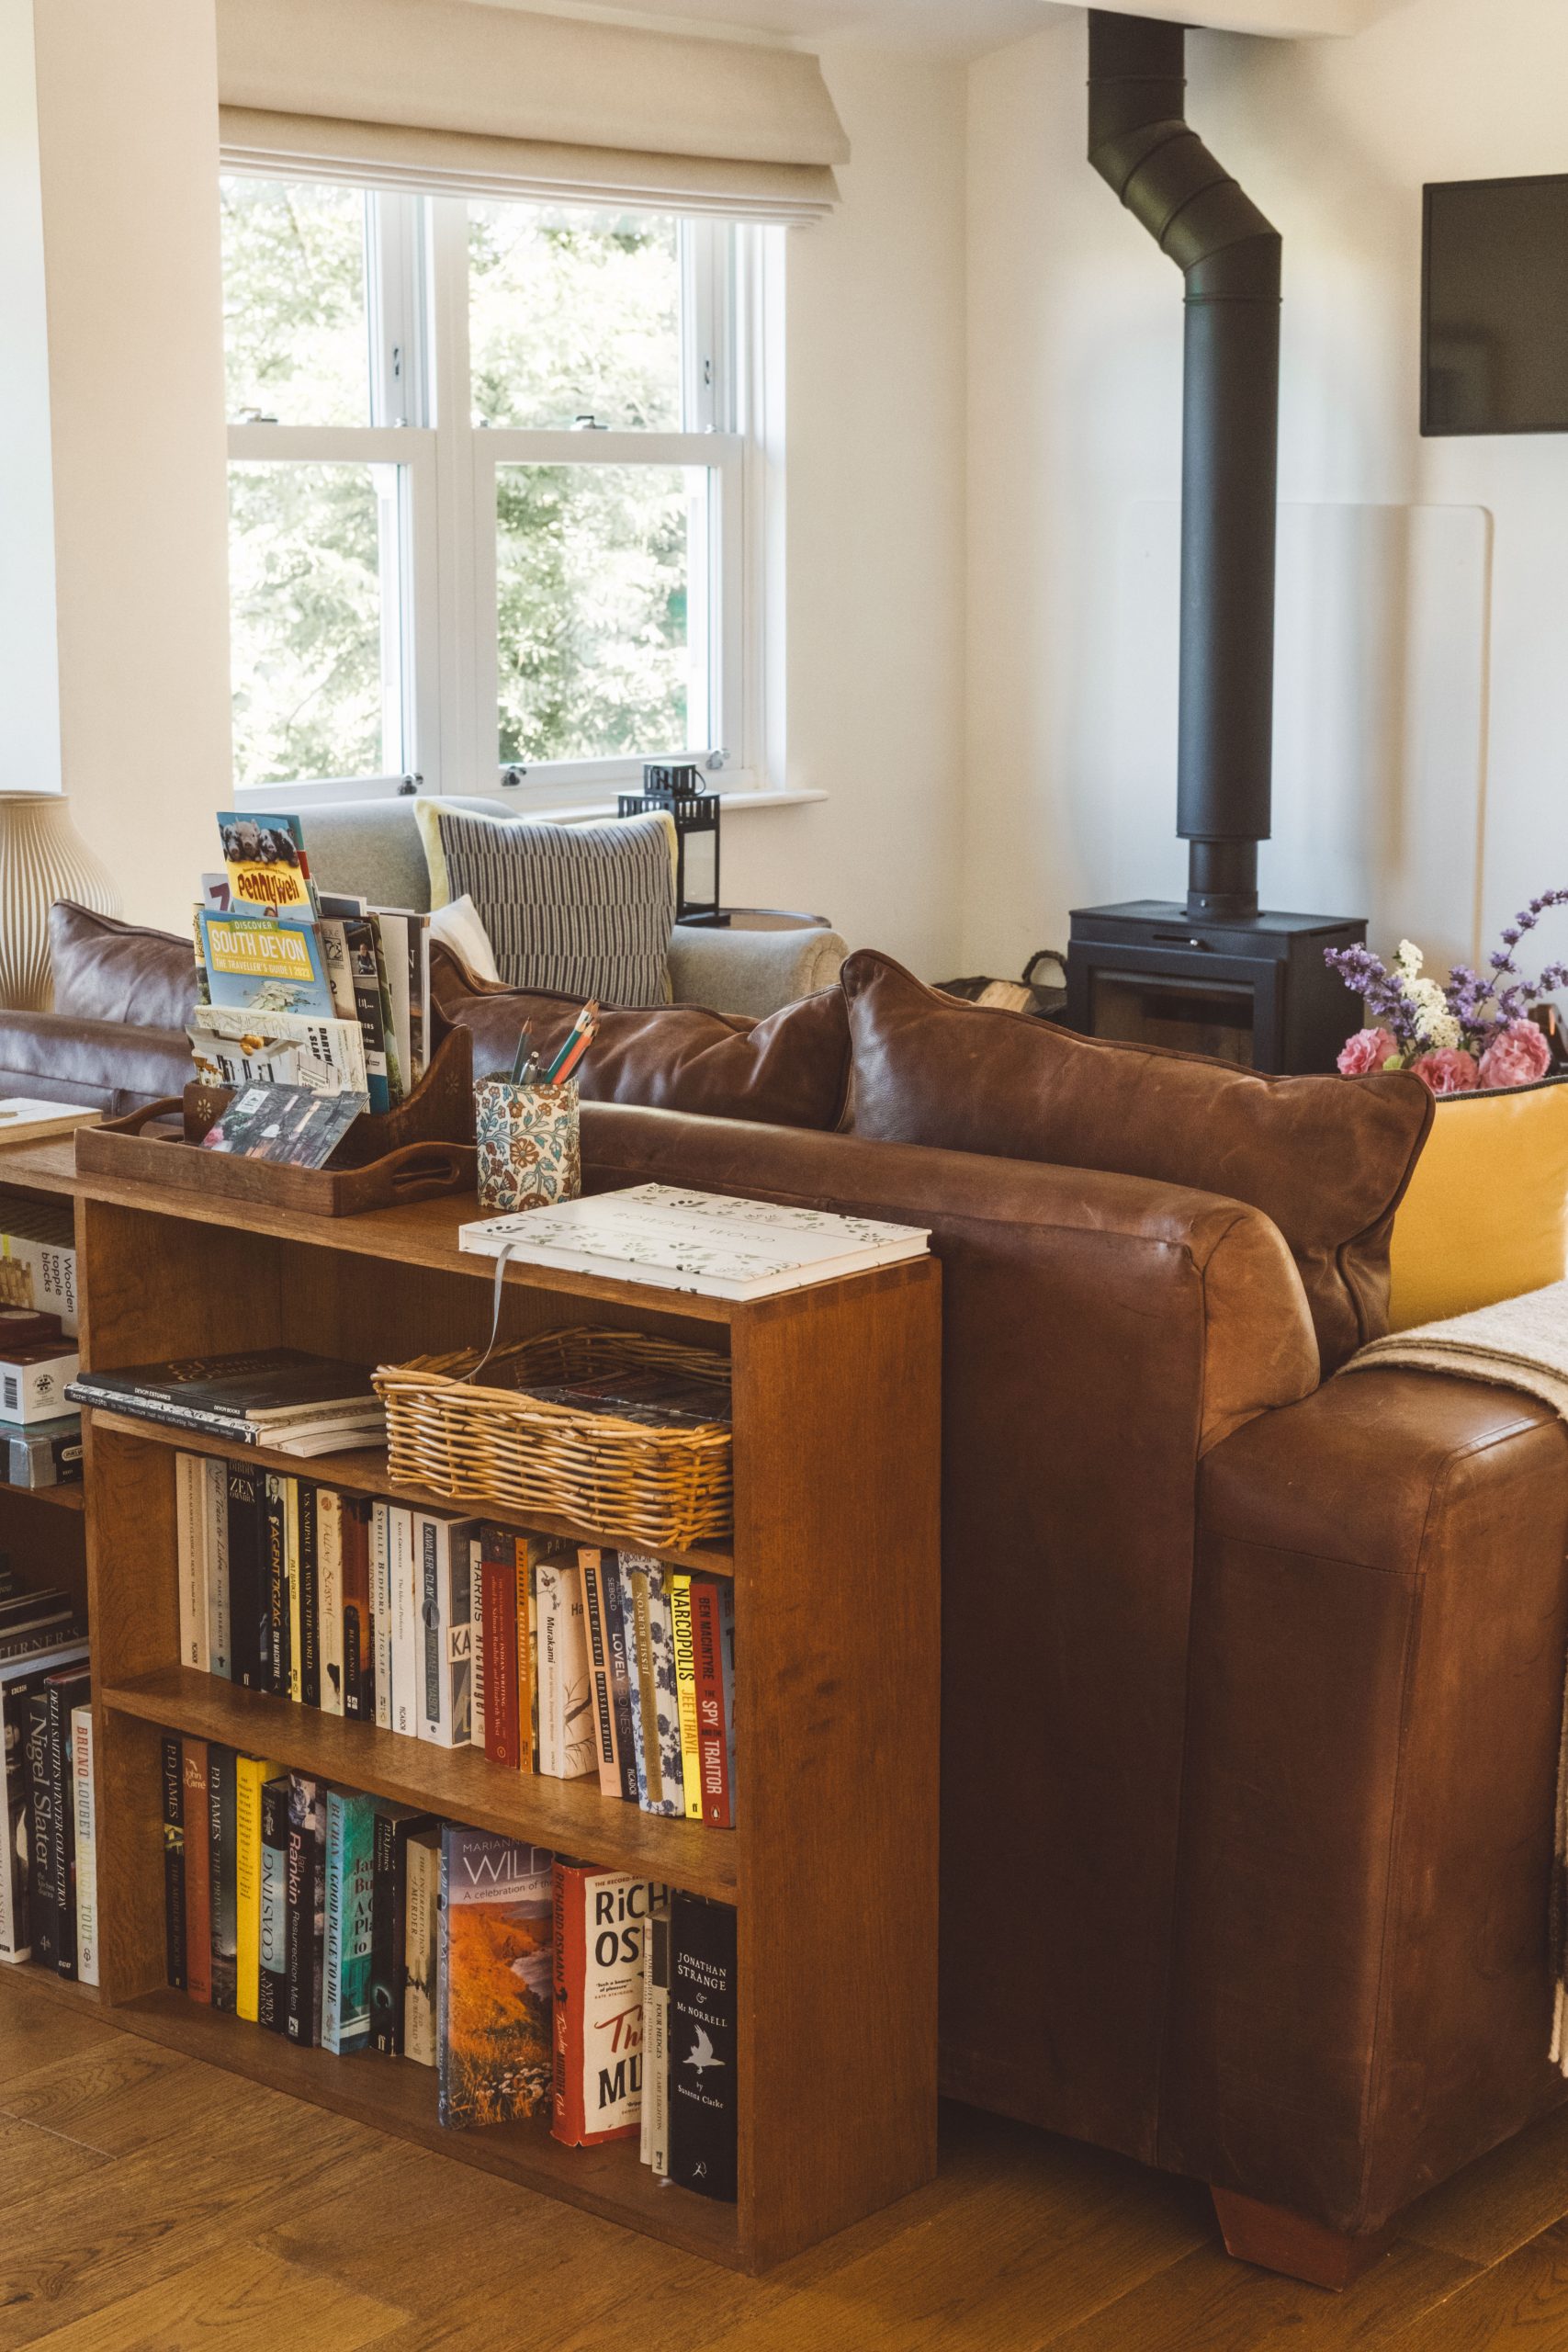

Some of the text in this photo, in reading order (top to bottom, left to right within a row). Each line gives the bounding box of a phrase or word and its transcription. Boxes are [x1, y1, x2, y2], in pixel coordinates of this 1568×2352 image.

[211, 929, 257, 956] SOUTH
[259, 934, 306, 962] DEVON
[234, 921, 273, 930] DISCOVER
[215, 957, 226, 968] THE
[41, 1251, 52, 1293] blocks
[51, 1254, 63, 1296] topple
[62, 1257, 75, 1314] Wooden
[230, 1476, 254, 1497] ZEN
[270, 1525, 280, 1577] AGENT
[377, 1510, 385, 1557] SYBILLE
[424, 1526, 434, 1569] KAVALIER
[272, 1578, 281, 1627] ZIGZAG
[425, 1574, 434, 1600] CLAY
[607, 1577, 617, 1611] SEBOLD
[571, 1603, 584, 1616] Ha
[547, 1616, 556, 1664] Murakami
[637, 1590, 650, 1676] JESSIE BURTON
[698, 1597, 715, 1680] BEN MACINTYRE
[273, 1644, 281, 1679] MACINTYRE
[673, 1588, 698, 1756] NARCOPOLIS JEET THAYIL
[612, 1633, 637, 1795] LOVELY BONES PICADOR
[702, 1700, 719, 1726] SPY
[77, 1726, 89, 1777] BRUNO
[704, 1739, 723, 1795] TRAITOR
[26, 1712, 51, 1871] Nigel Slater
[78, 1781, 91, 1841] LOUBET
[165, 1770, 178, 1818] JAMES
[210, 1793, 221, 1841] JAMES
[463, 1847, 555, 1884] WILD
[263, 1853, 274, 1962] COASTING
[330, 1873, 339, 1914] GOOD
[463, 1882, 539, 1900] A celebration of
[81, 1905, 93, 1944] TOUT
[288, 1831, 301, 2012] Rankin Resurrection Men
[328, 1916, 339, 1957] PLACE
[354, 1940, 367, 1955] to
[554, 1931, 566, 1983] OSMAN
[594, 1926, 645, 1967] OS
[678, 1952, 727, 1977] JONATHAN
[328, 1961, 338, 1980] TO
[677, 1964, 727, 1991] STRANGE
[265, 1980, 275, 2023] RABAN
[327, 1984, 337, 2007] DIE
[695, 1992, 707, 2004] &
[688, 2007, 728, 2028] NORRELL
[678, 2084, 725, 2109] Susanna Clarke
[695, 2081, 704, 2092] by
